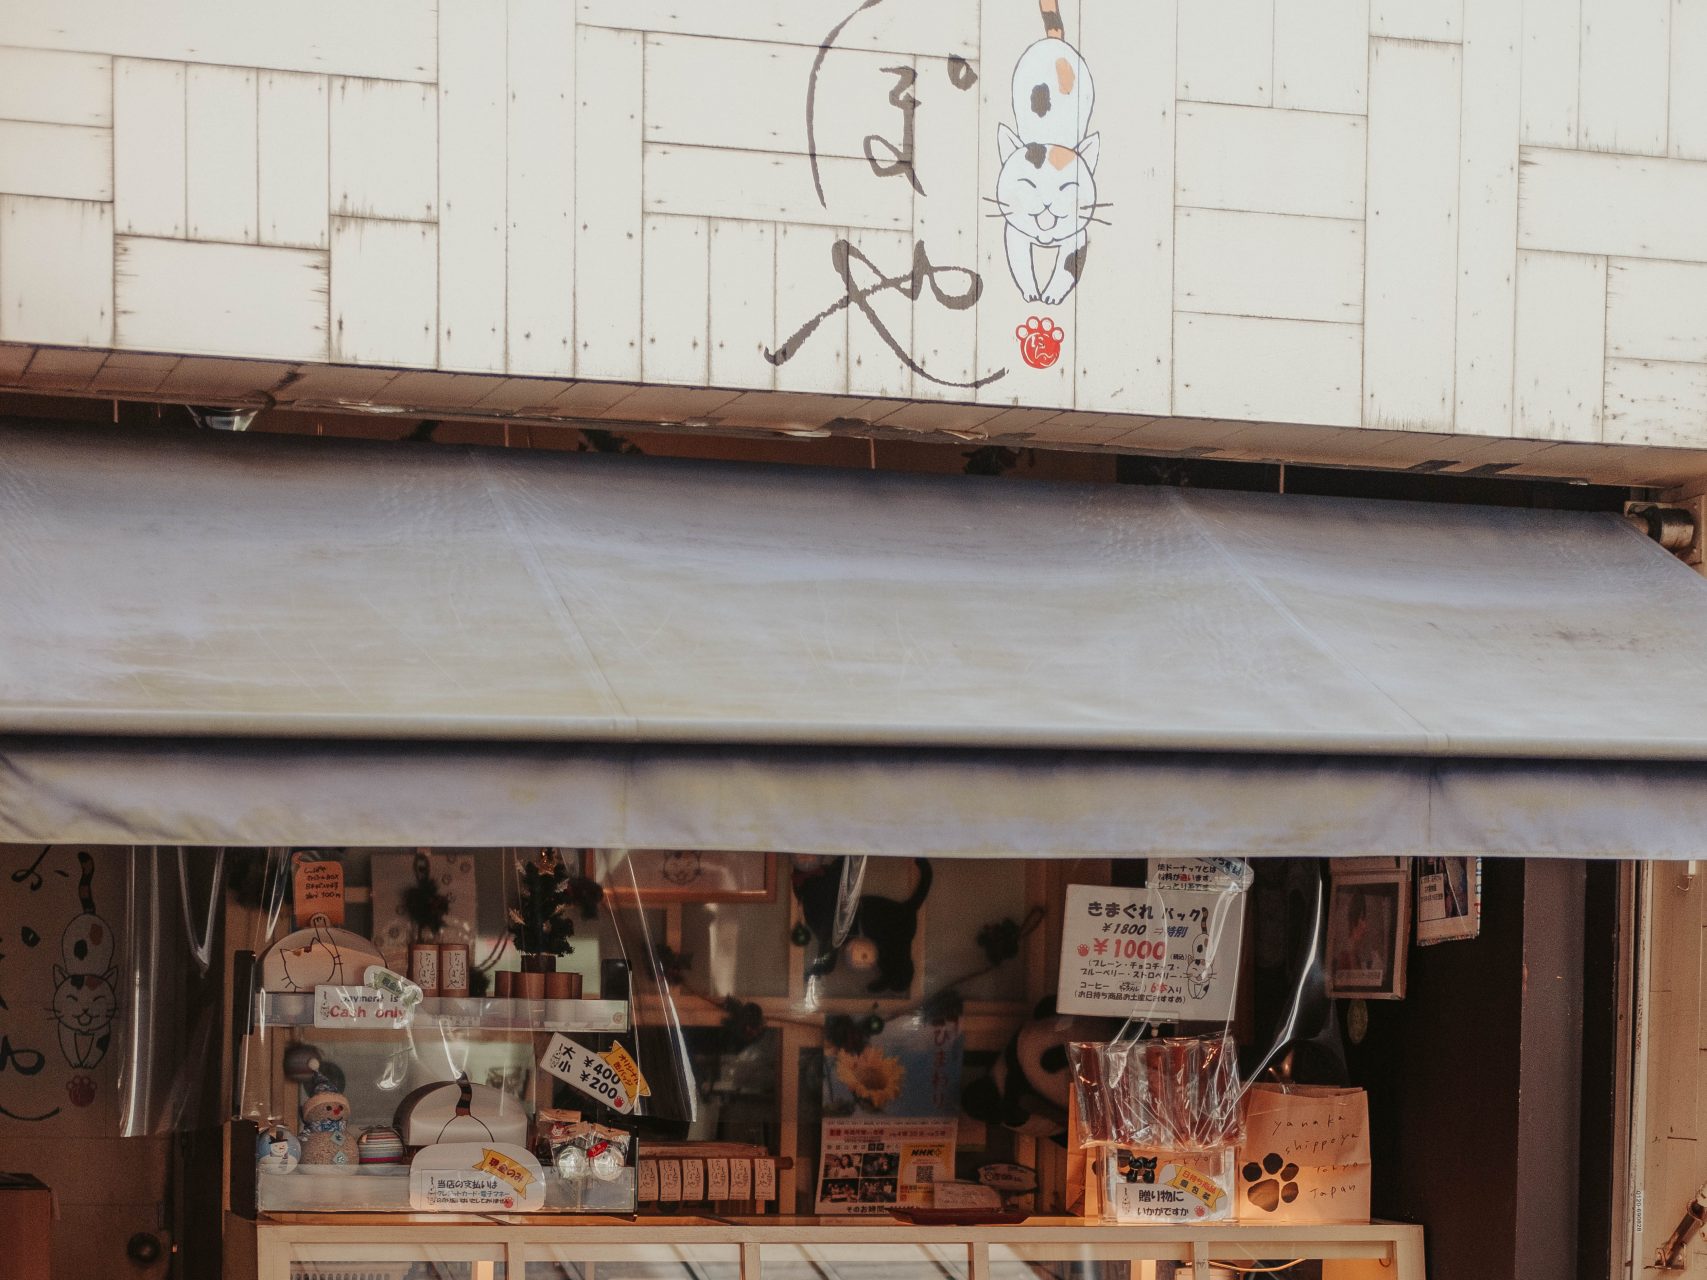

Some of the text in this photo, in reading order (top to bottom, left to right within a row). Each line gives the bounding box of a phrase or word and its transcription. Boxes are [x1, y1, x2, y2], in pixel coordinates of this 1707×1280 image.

[1087, 901, 1154, 918] きまぐれ
[1102, 923, 1147, 936] ¥1800
[1093, 938, 1166, 960] ¥1000
[330, 1005, 367, 1019] Cash
[562, 1045, 576, 1060] 大
[583, 1055, 621, 1085] ¥400
[558, 1060, 619, 1100] 小 ¥200
[1138, 1189, 1185, 1204] 贈り物に
[1138, 1207, 1189, 1216] いかがですか
